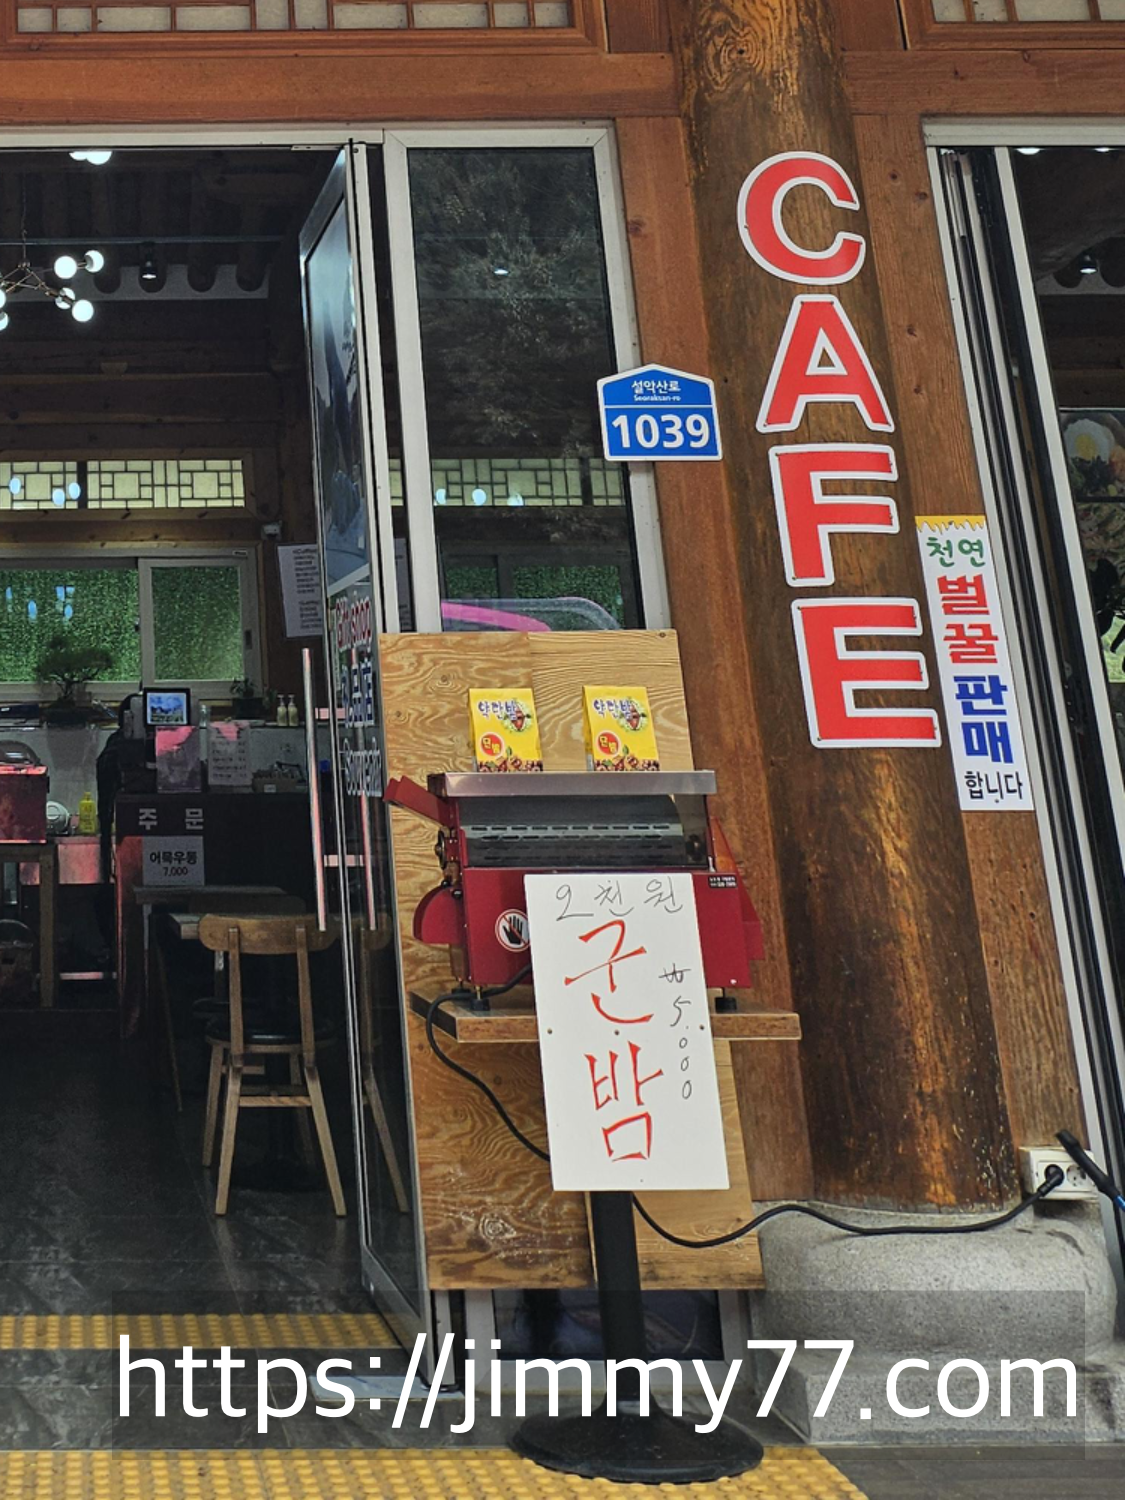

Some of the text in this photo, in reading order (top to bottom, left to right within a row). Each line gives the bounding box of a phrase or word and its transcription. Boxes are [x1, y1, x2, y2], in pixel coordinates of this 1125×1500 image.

[631, 380, 682, 395] 설악산로
[633, 394, 682, 402] Seoraksan-ro
[611, 413, 711, 449] 1039
[737, 150, 942, 749] CAFE
[926, 537, 986, 568] 천연
[936, 573, 999, 664] 벌꿀
[953, 674, 1014, 764] 판매
[964, 771, 1024, 801] 합니다
[564, 918, 665, 1163] 군밤
